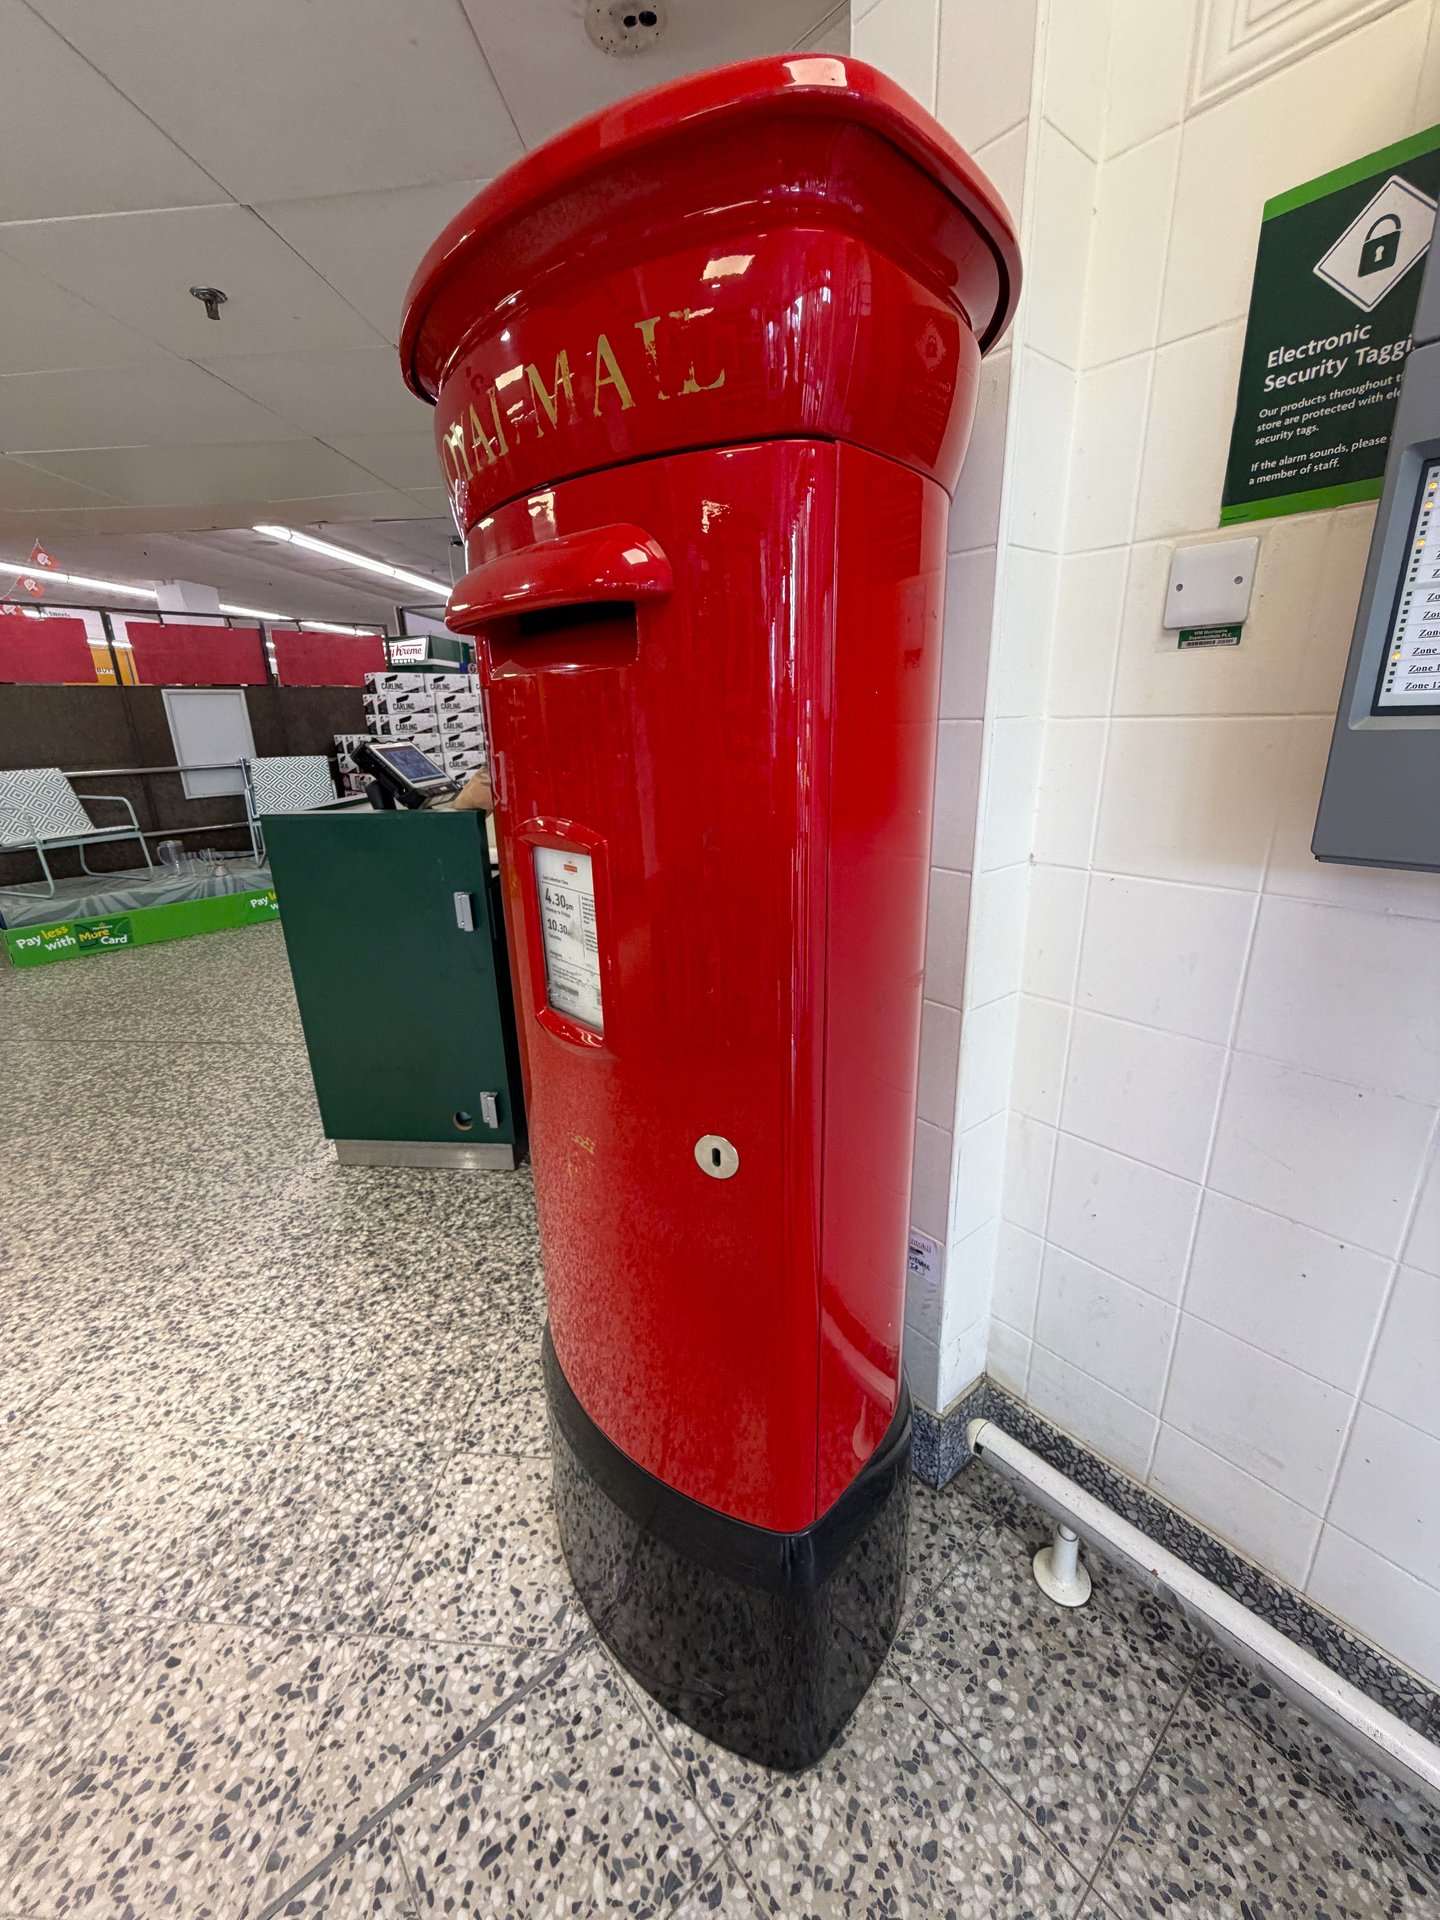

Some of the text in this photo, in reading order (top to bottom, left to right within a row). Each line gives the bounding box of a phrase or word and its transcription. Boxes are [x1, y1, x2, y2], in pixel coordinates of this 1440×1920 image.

[1267, 324, 1372, 368] Electronic
[1263, 333, 1415, 392] Security Taggi
[1259, 408, 1278, 419] Our
[1280, 394, 1327, 416] products
[1329, 374, 1393, 401] throughout
[1256, 420, 1282, 433] store
[1284, 415, 1300, 426] are
[1302, 399, 1356, 423] protected
[1358, 391, 1384, 407] with
[1254, 423, 1320, 446] security tags.
[1250, 461, 1260, 472] If
[1261, 459, 1277, 470] the
[1279, 454, 1307, 466] alarm
[1309, 443, 1349, 460] sounds,
[1351, 435, 1388, 453] please
[1248, 457, 1340, 486] a member of staff.
[1412, 647, 1438, 656] Zone
[1408, 664, 1434, 673] Zone
[381, 682, 404, 690] CARLING
[430, 683, 451, 691] CARLING
[1404, 682, 1430, 691] Zone
[393, 702, 415, 711] CARLING
[440, 703, 461, 711] CARLING
[395, 723, 418, 732] CARLING
[443, 722, 463, 731] CARLING
[445, 741, 466, 749] CARLING
[250, 896, 268, 908] Pay
[15, 925, 69, 949] Pay less
[45, 934, 77, 951] with
[101, 934, 128, 945] Card
